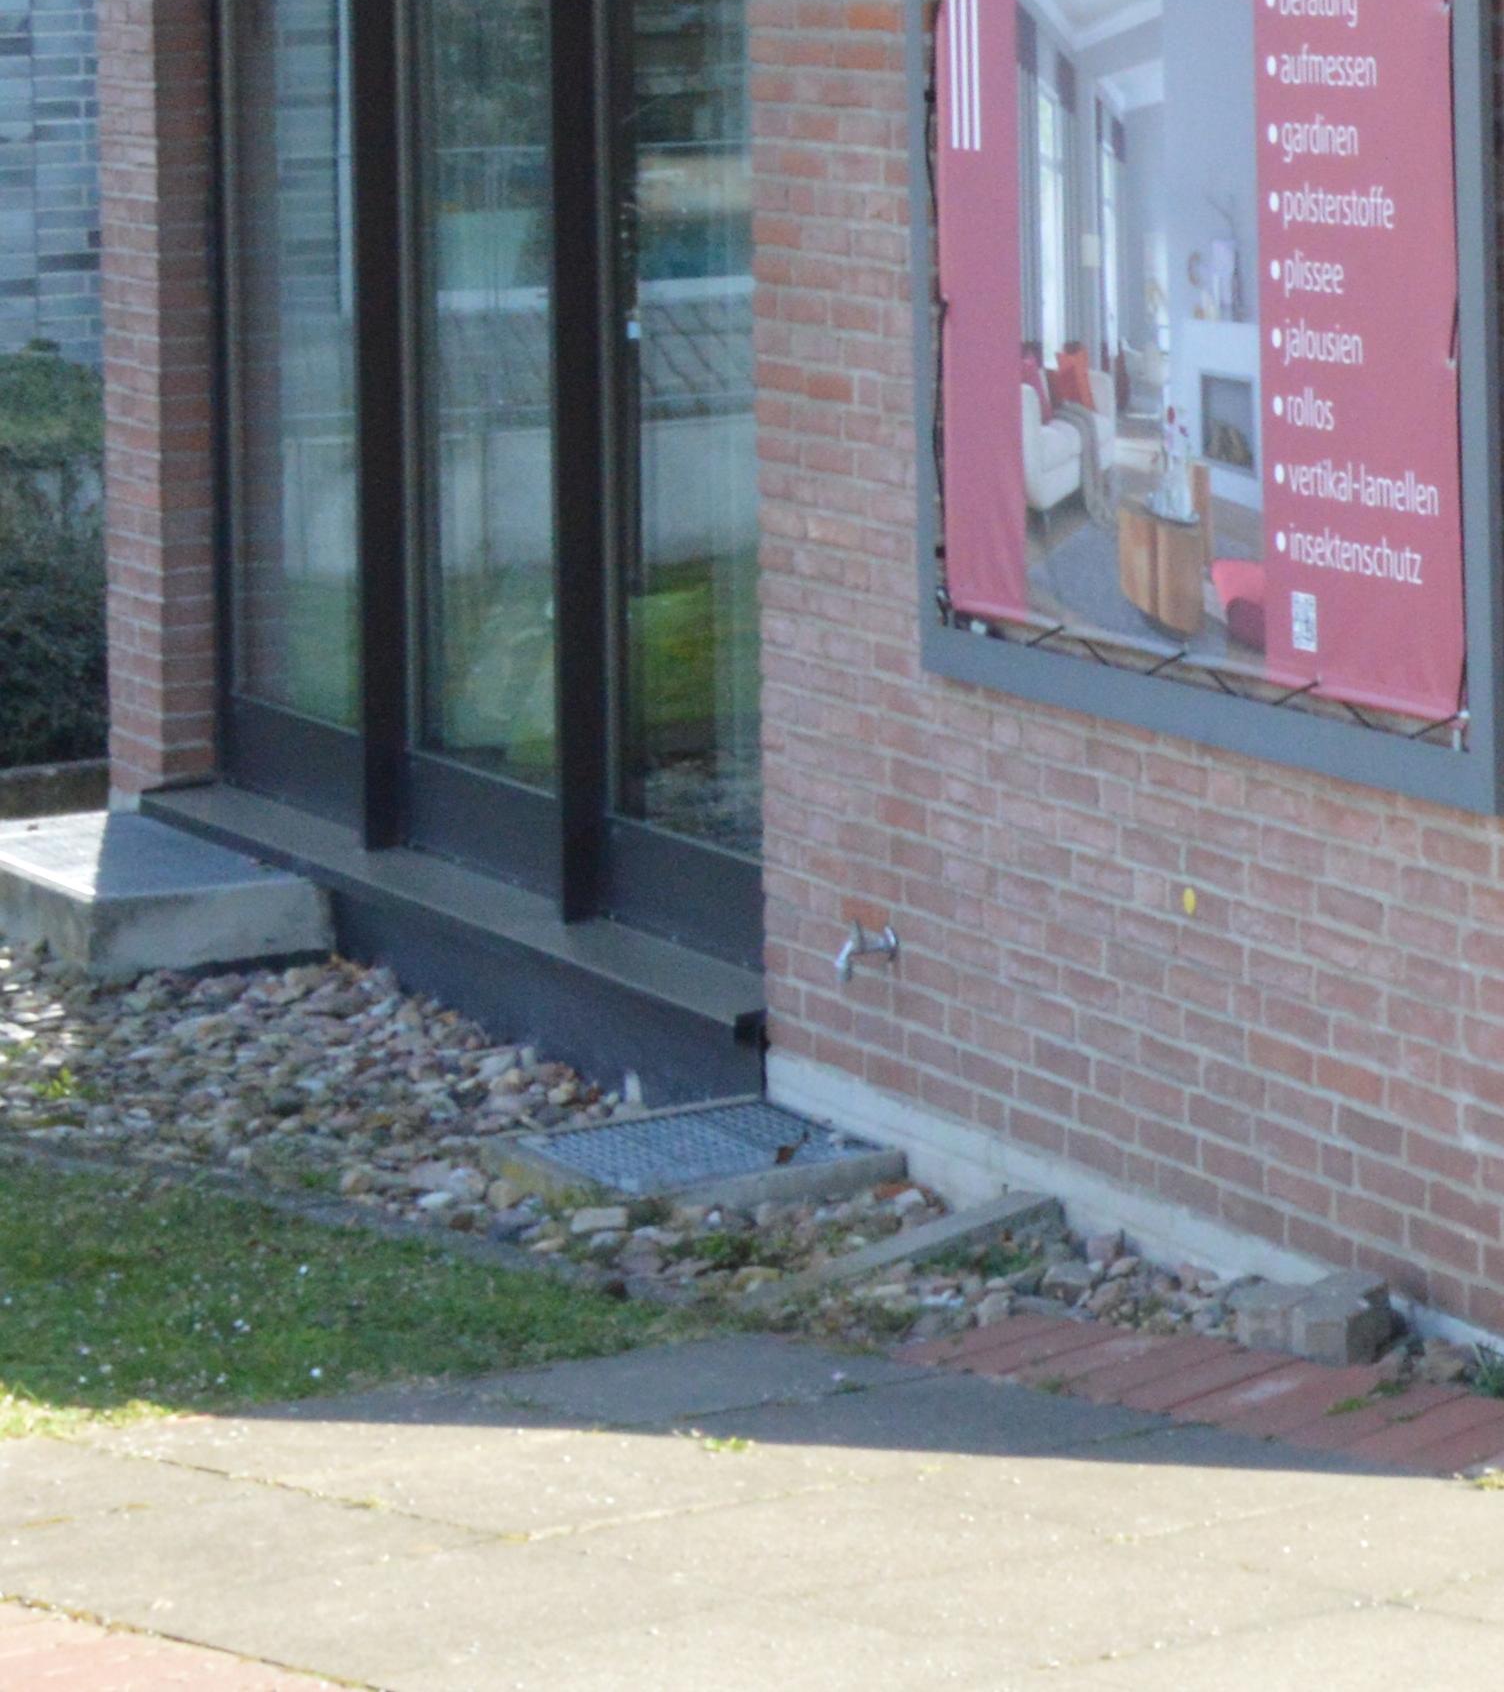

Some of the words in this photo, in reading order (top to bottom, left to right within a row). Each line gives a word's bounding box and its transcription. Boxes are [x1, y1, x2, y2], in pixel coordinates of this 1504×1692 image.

[1279, 44, 1377, 88] aufmessen
[1281, 113, 1359, 164] gardinen
[1282, 184, 1396, 230] polsterstoffe
[1283, 249, 1345, 298] plissee
[1283, 322, 1364, 367] jalousien
[1286, 388, 1335, 432] rollos
[1287, 458, 1440, 517] vertikal-lamellen
[1289, 522, 1424, 586] insektenschutz
